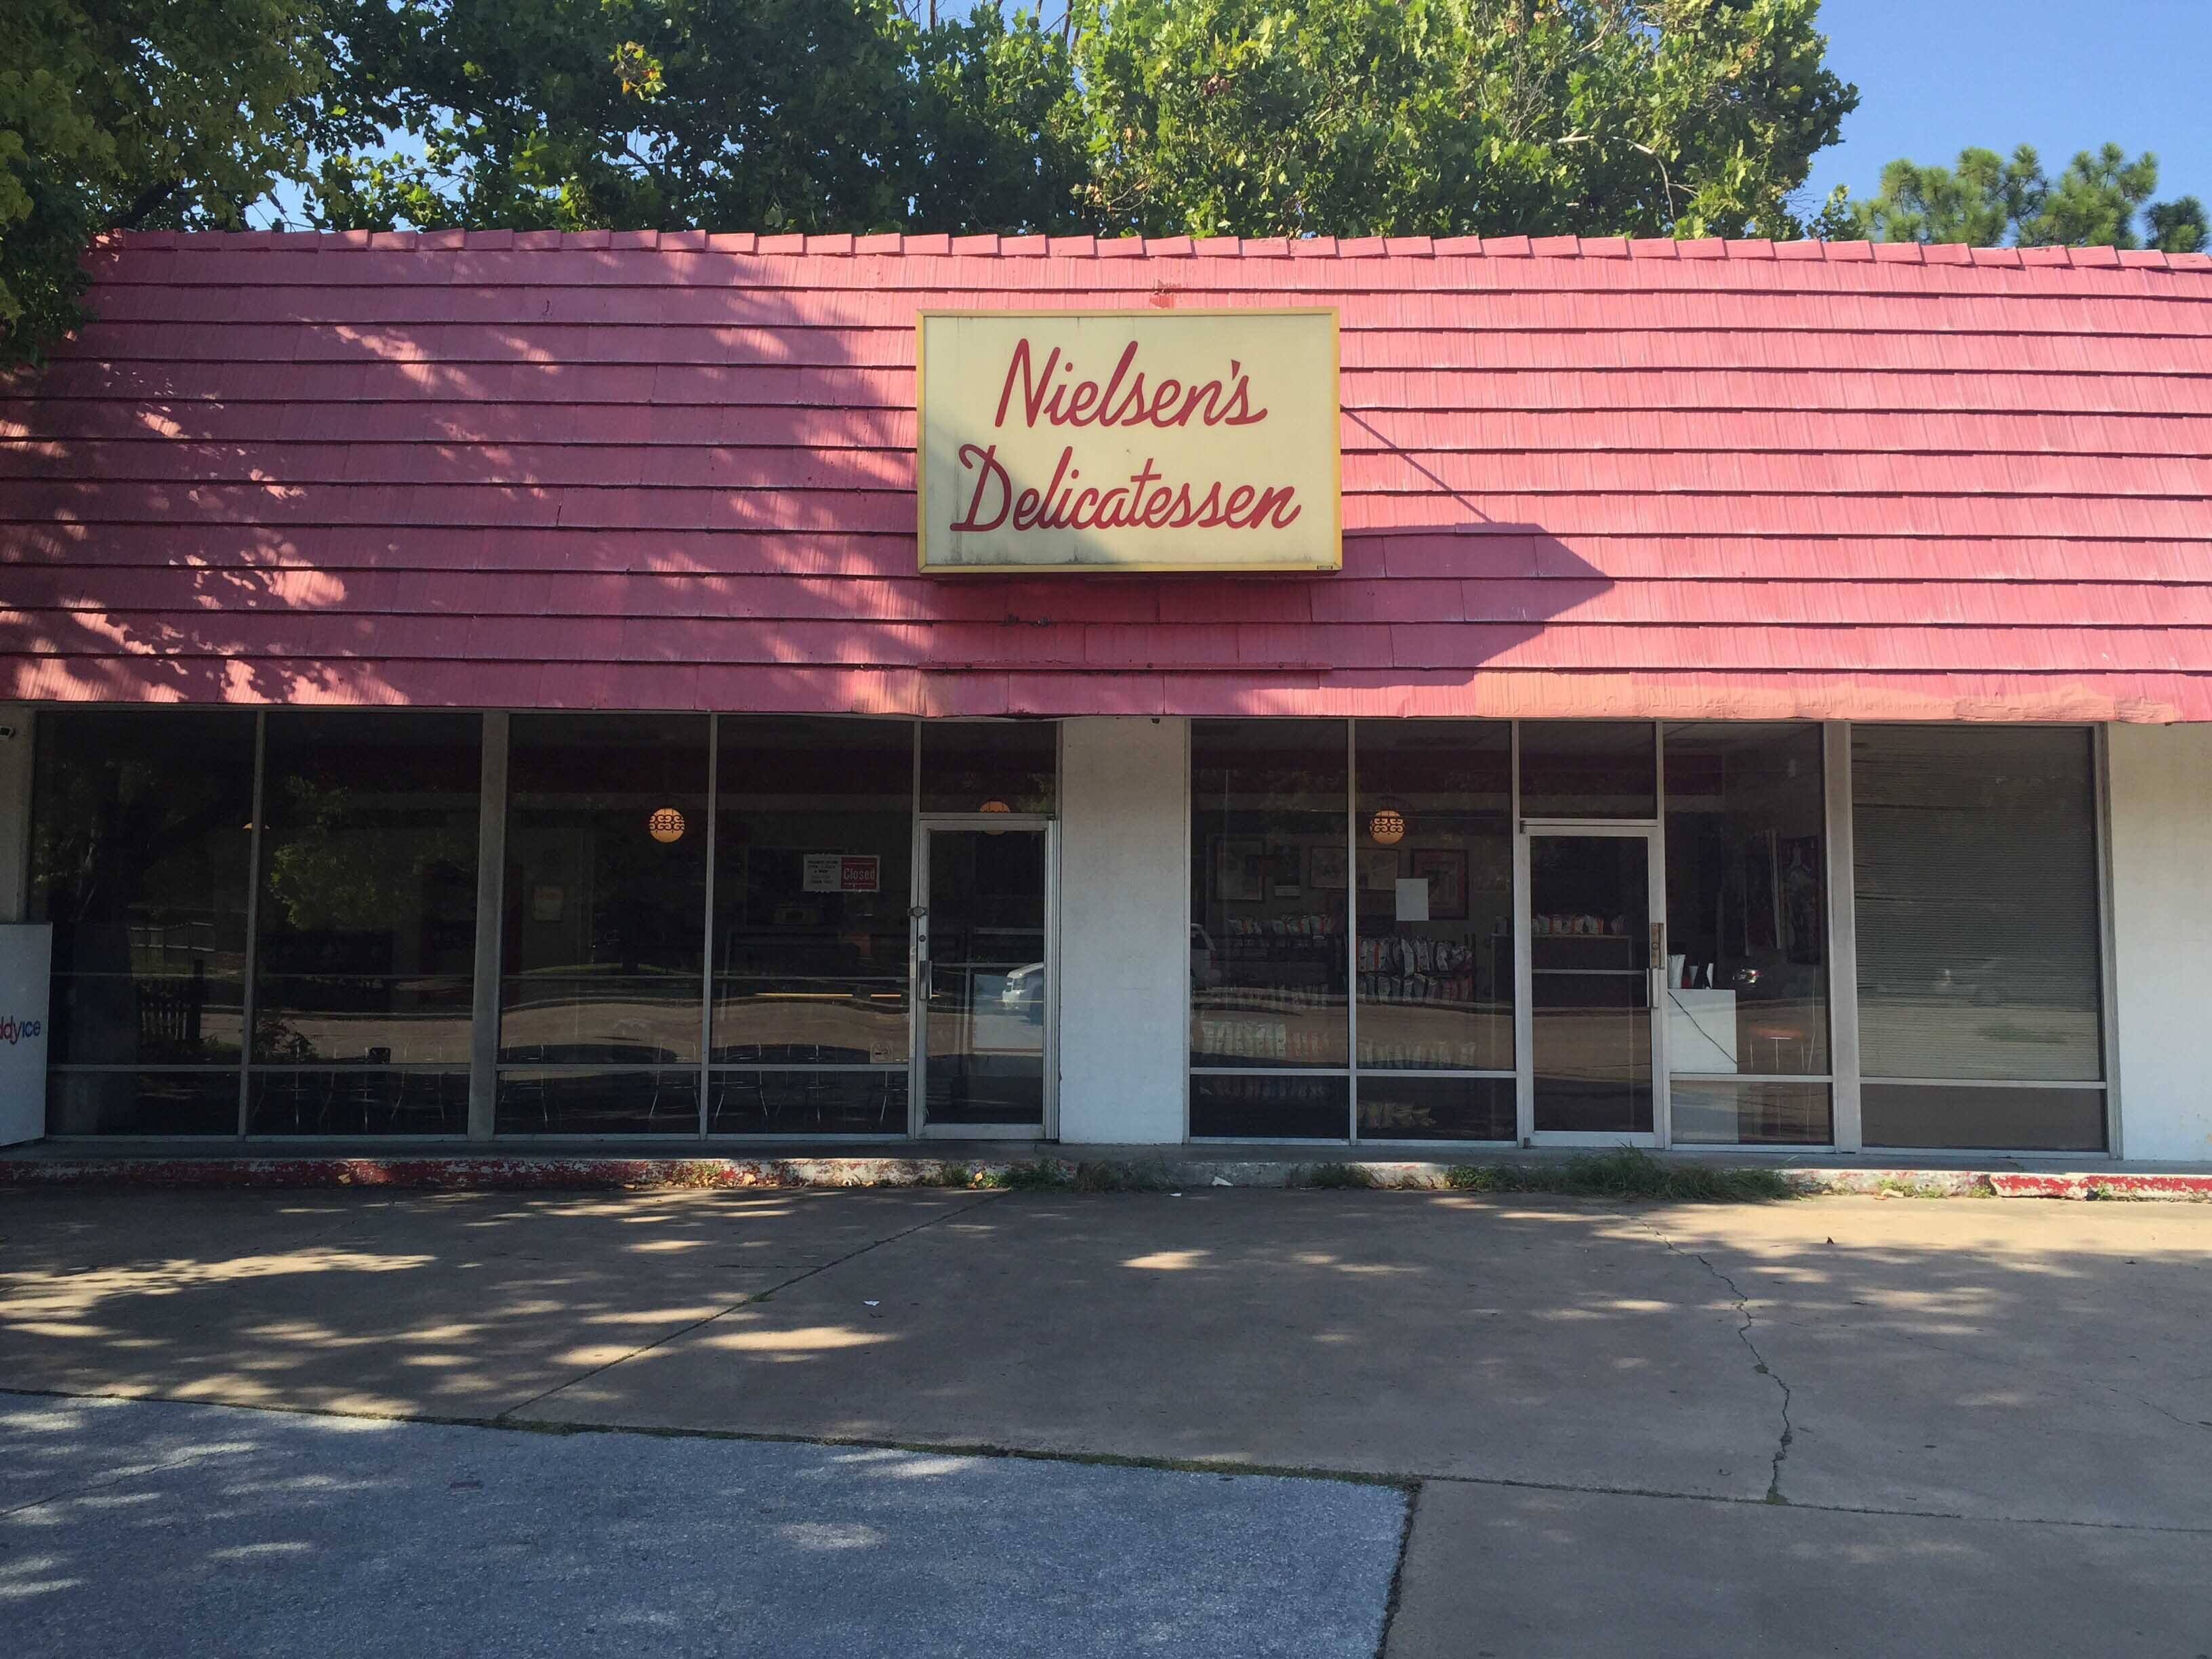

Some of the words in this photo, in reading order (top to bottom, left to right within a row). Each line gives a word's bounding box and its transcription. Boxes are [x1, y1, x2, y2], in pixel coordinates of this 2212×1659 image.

[994, 338, 1269, 428] Nielsen's
[949, 444, 1302, 531] Delicatessen
[844, 867, 876, 880] Closed
